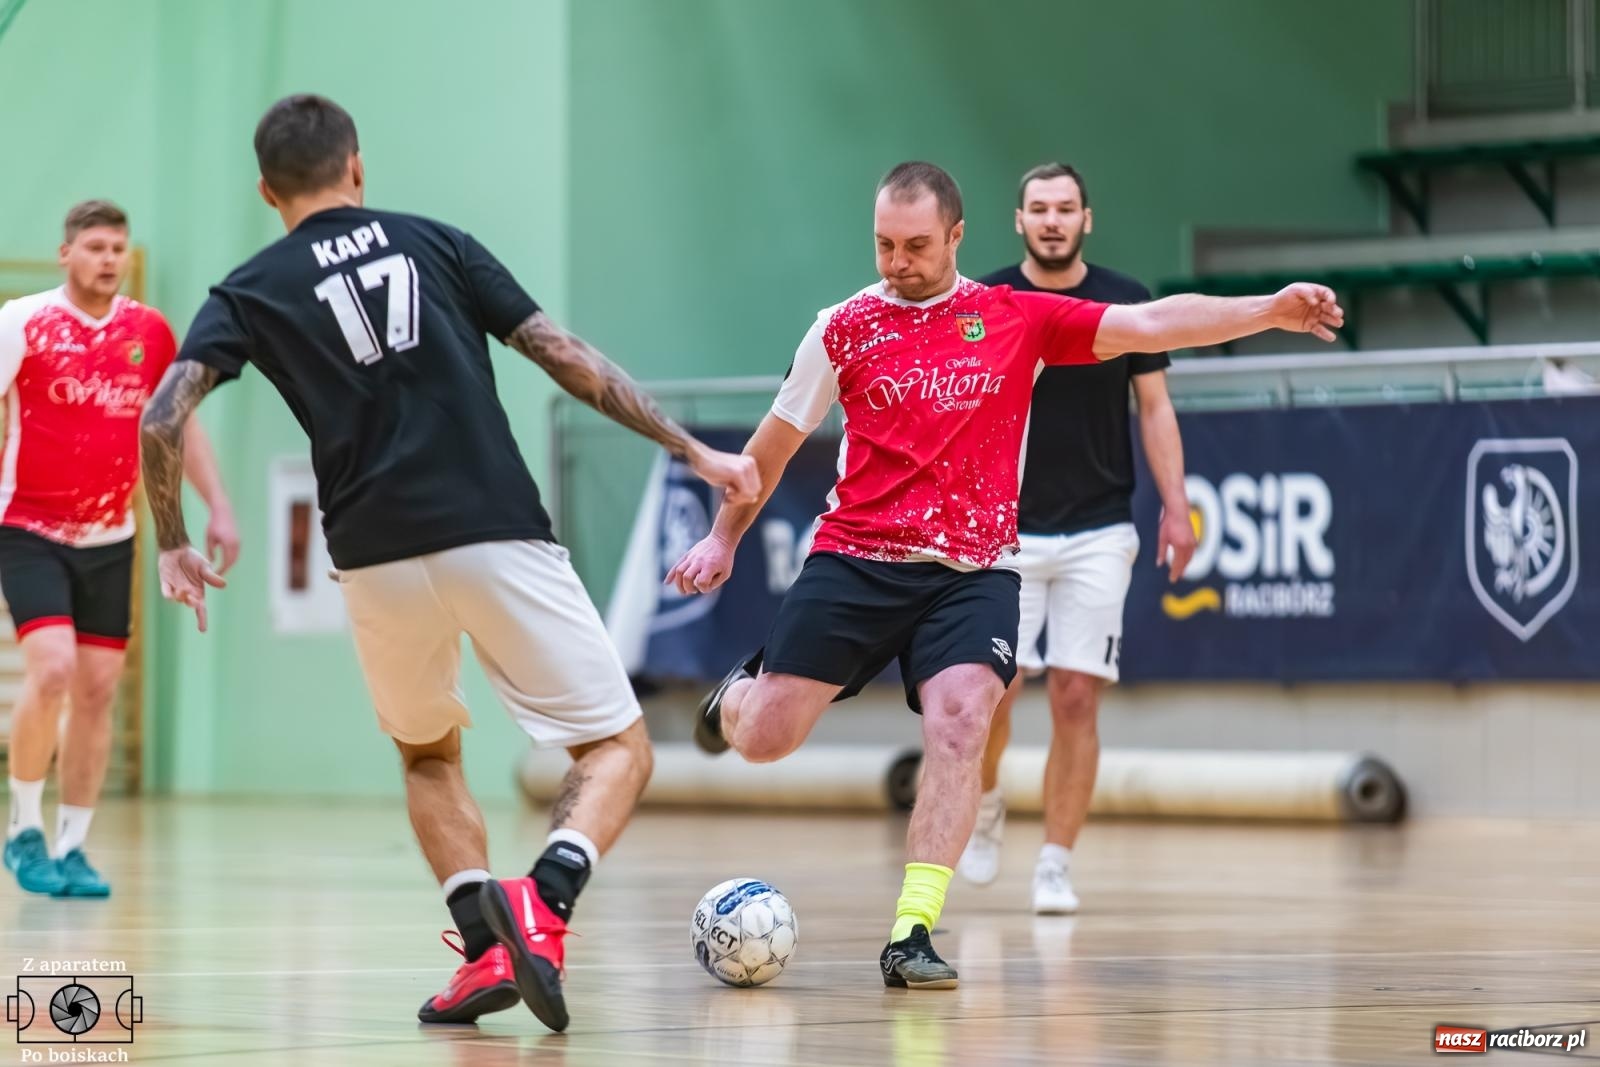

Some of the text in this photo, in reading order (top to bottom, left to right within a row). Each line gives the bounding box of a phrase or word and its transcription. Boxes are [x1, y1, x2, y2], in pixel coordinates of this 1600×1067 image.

[311, 221, 389, 268] KAPI
[314, 253, 420, 366] 17
[945, 357, 982, 369] Willa
[865, 367, 1005, 410] Wiktoria
[1159, 472, 1335, 580] OSiR
